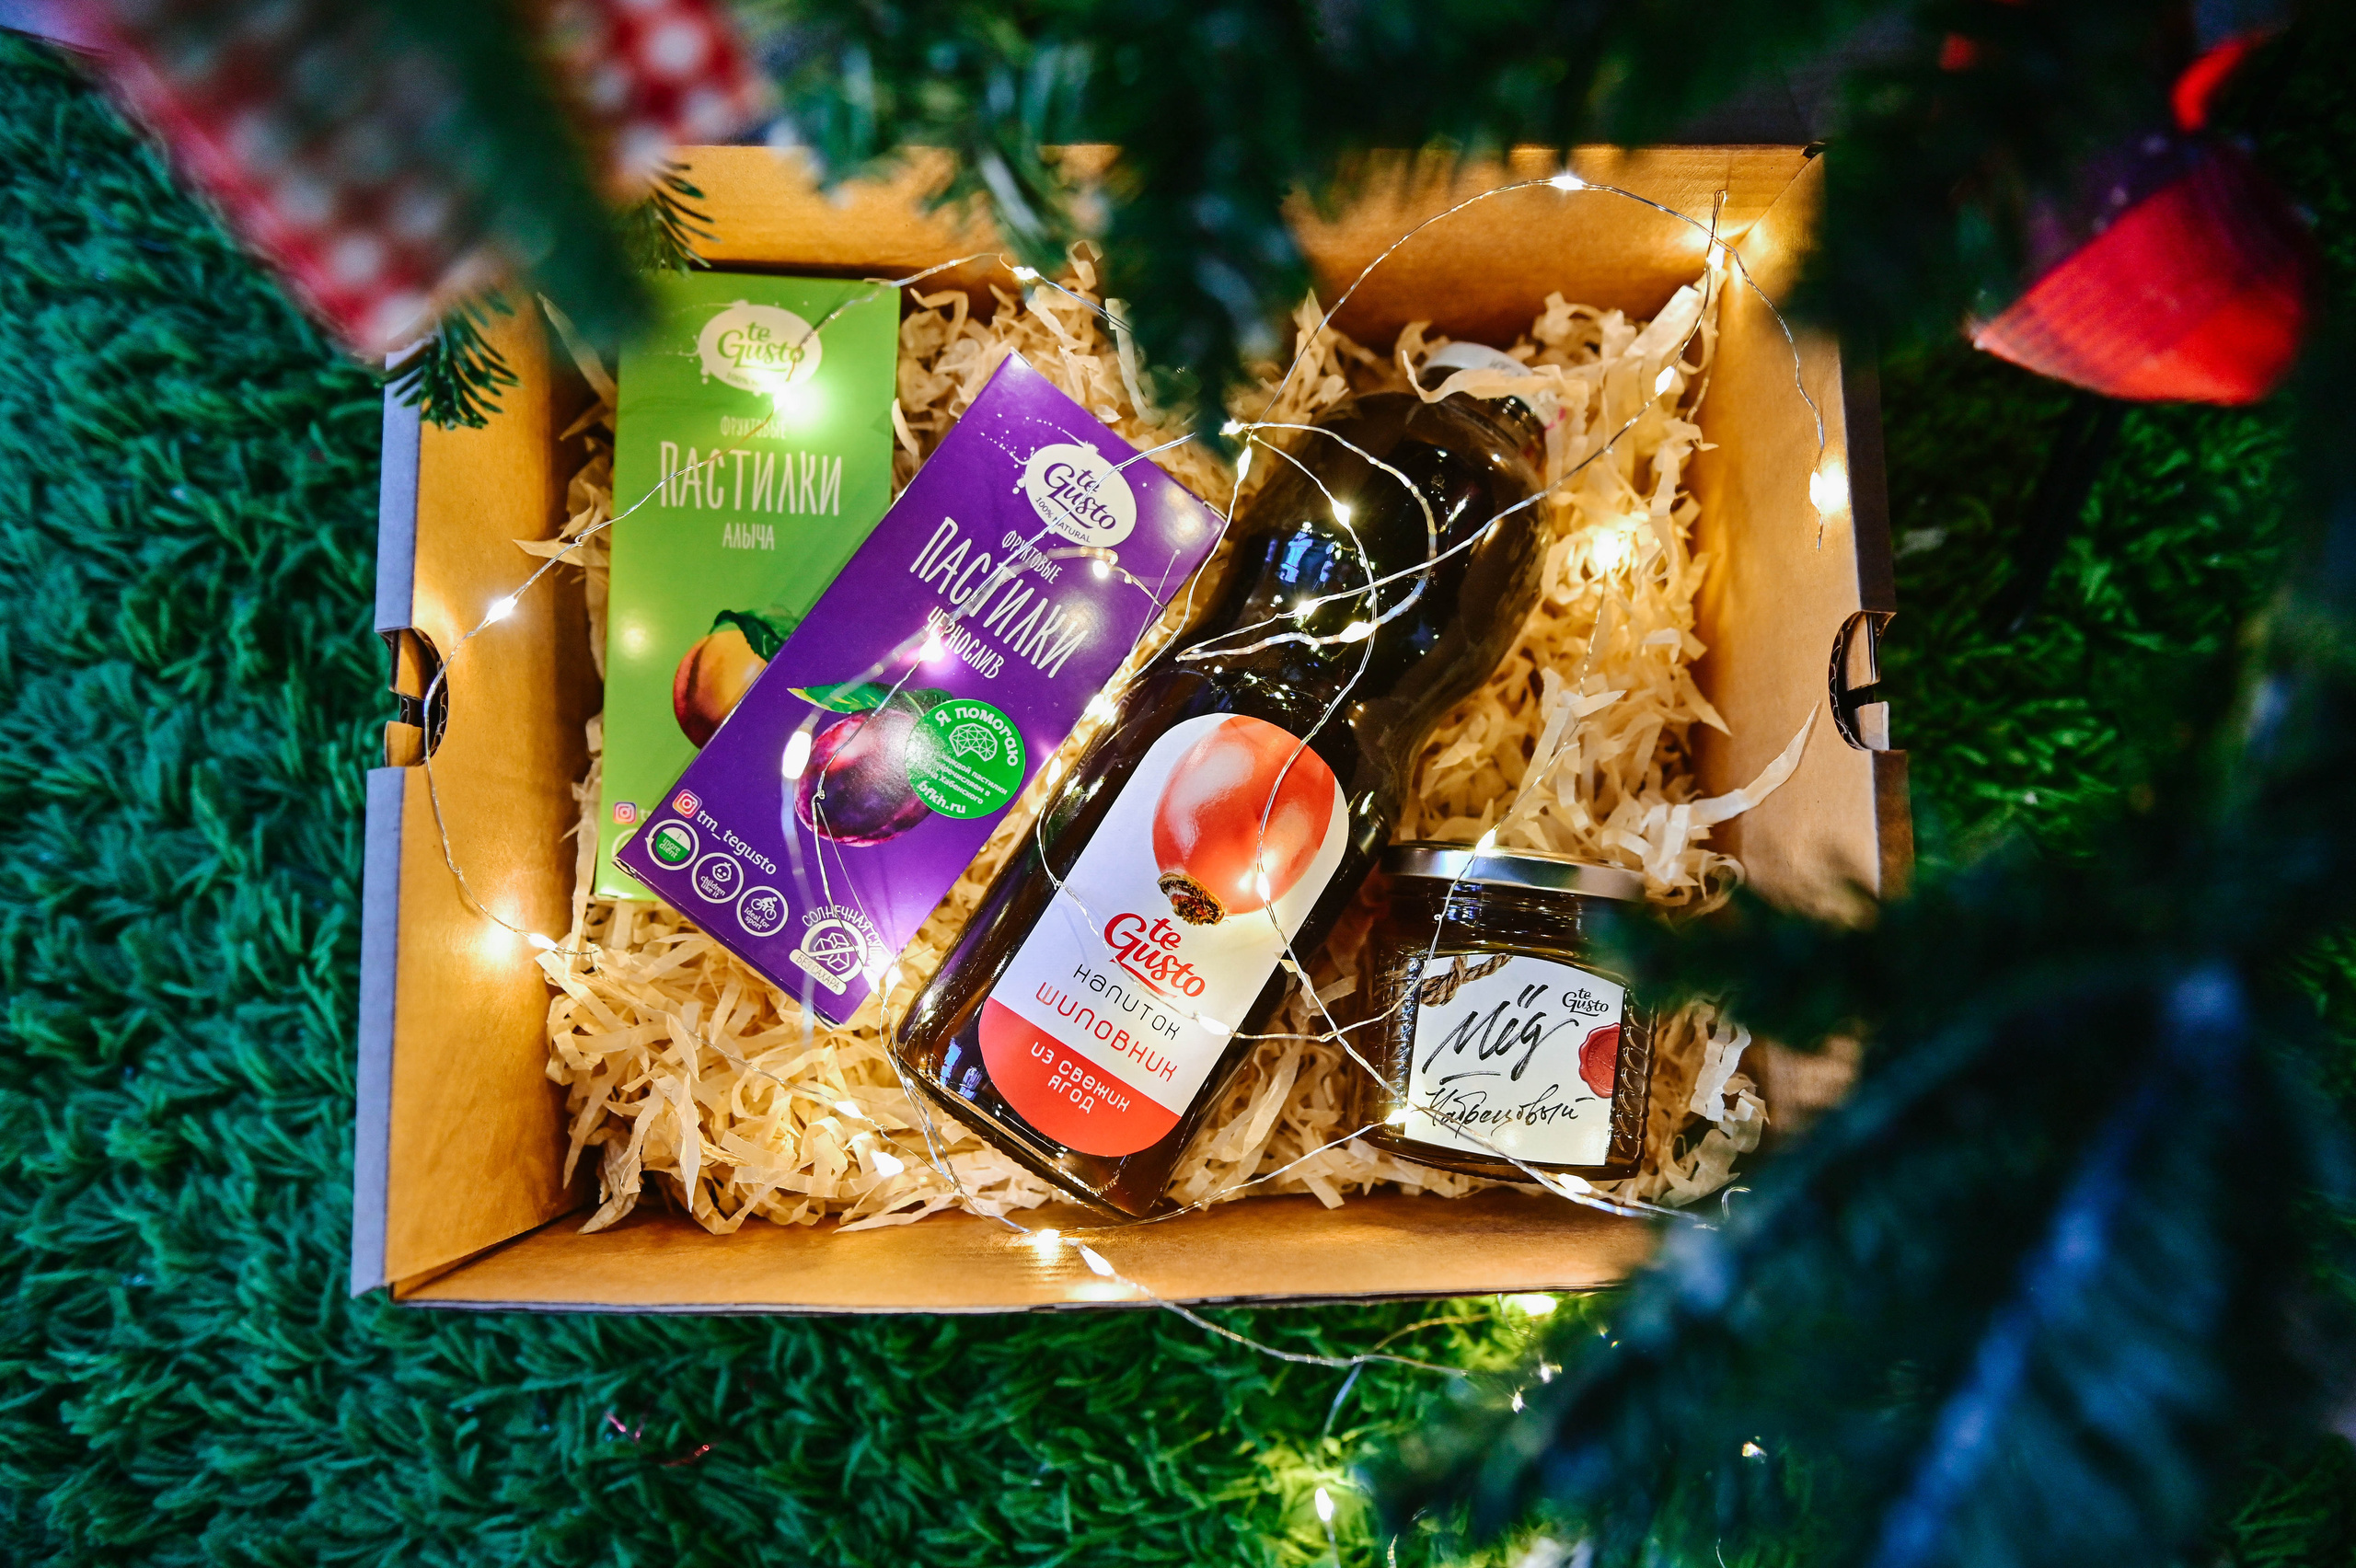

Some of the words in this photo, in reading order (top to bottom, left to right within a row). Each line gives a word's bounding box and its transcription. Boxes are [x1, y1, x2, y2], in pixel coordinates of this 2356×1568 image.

[747, 322, 771, 341] te
[717, 329, 805, 372] Gusto
[660, 441, 842, 516] ПАСТИЛКИ
[1077, 469, 1100, 492] te
[1035, 497, 1054, 518] 100%
[1044, 463, 1115, 529] Gusto
[722, 523, 775, 550] АЛЫЧА
[1002, 530, 1062, 584] ФРУКТОВЫЕ
[909, 516, 1088, 678] ПАСТИЛКИ
[925, 605, 1004, 678] ЧЕРНОСЛИВ
[935, 709, 952, 727] Я
[955, 707, 1018, 766] помогаю
[917, 780, 966, 813] bfkh.ru
[939, 774, 984, 804] Хабенского
[971, 771, 1008, 795] пастилки
[697, 810, 777, 875] tm_tegusto
[700, 875, 726, 896] children
[745, 916, 763, 930] sport
[760, 918, 770, 928] for
[802, 905, 872, 932] СОЛНЕЧНАЯ
[1149, 917, 1182, 951] te
[1103, 912, 1206, 998] Gusto
[796, 953, 813, 969] БЕЗ
[812, 965, 840, 991] САХАРА
[1562, 991, 1609, 1017] Gusto
[1578, 987, 1591, 999] te
[1422, 984, 1579, 1081] Мёд
